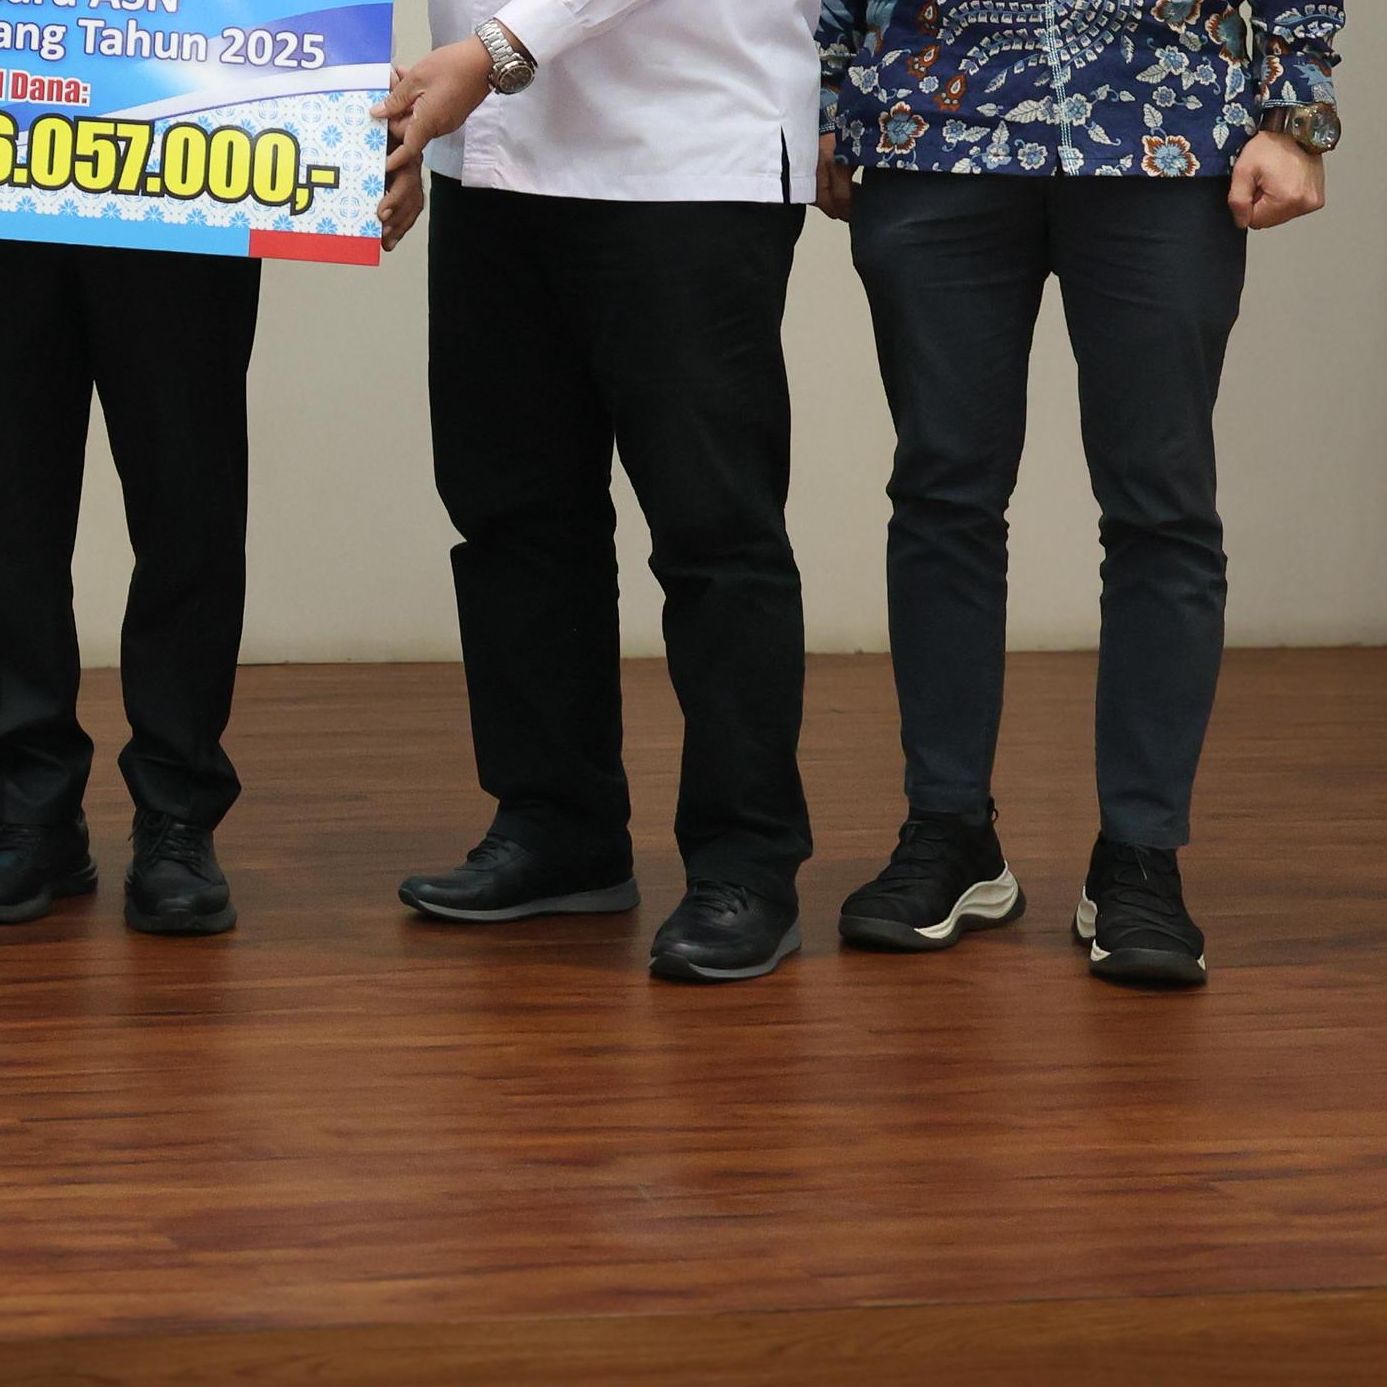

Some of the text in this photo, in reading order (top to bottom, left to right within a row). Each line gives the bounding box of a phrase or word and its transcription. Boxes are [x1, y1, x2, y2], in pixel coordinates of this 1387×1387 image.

[78, 18, 208, 63] Tahun
[219, 26, 325, 70] 2025
[9, 70, 92, 107] Dana:
